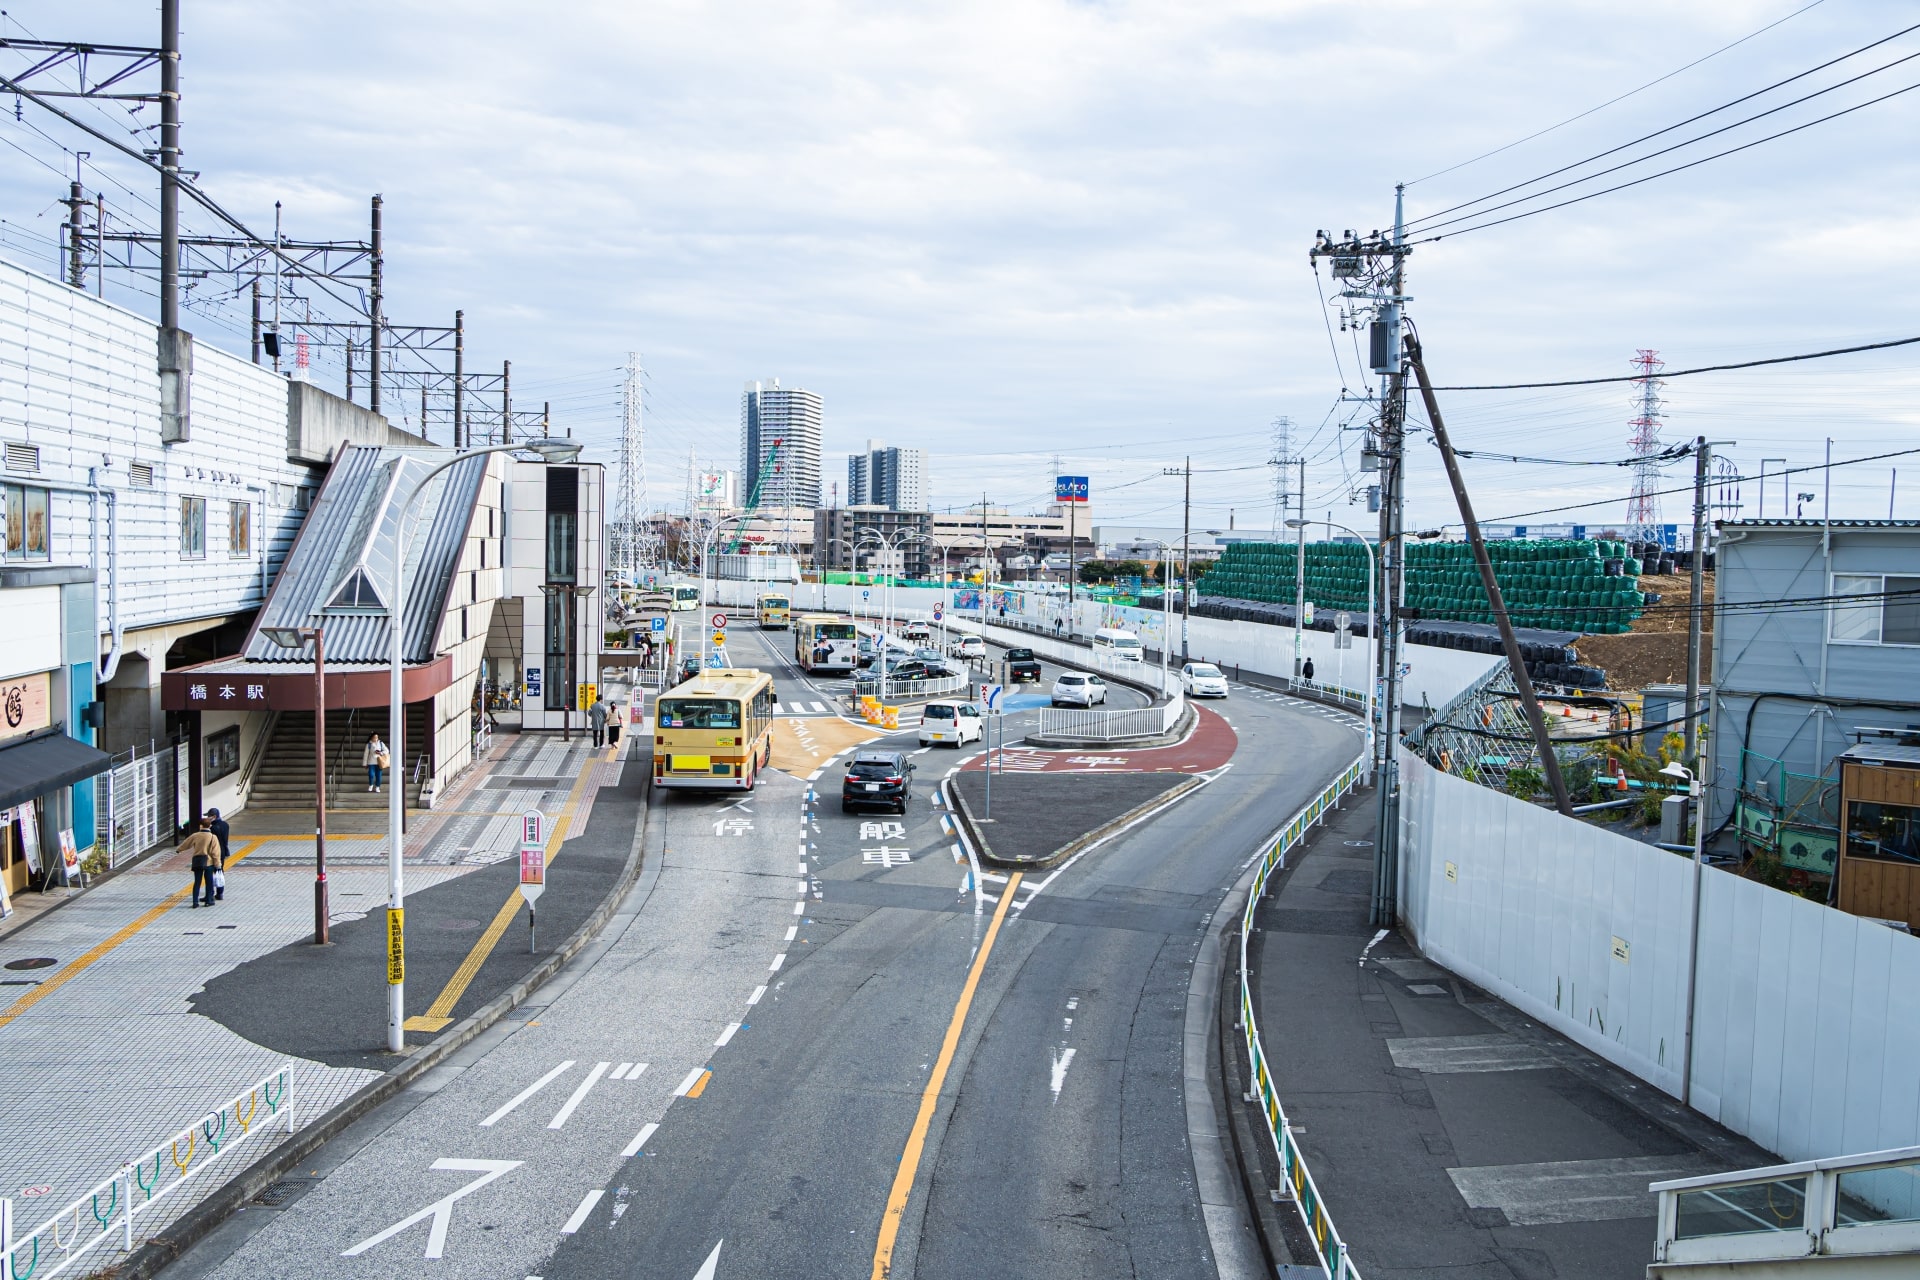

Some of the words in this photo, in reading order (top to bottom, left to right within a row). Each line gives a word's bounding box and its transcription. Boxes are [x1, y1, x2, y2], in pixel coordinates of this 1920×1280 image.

[655, 619, 663, 629] P
[190, 683, 264, 700] 橋本駅
[528, 816, 536, 842] 降車場
[340, 1060, 649, 1259] バス
